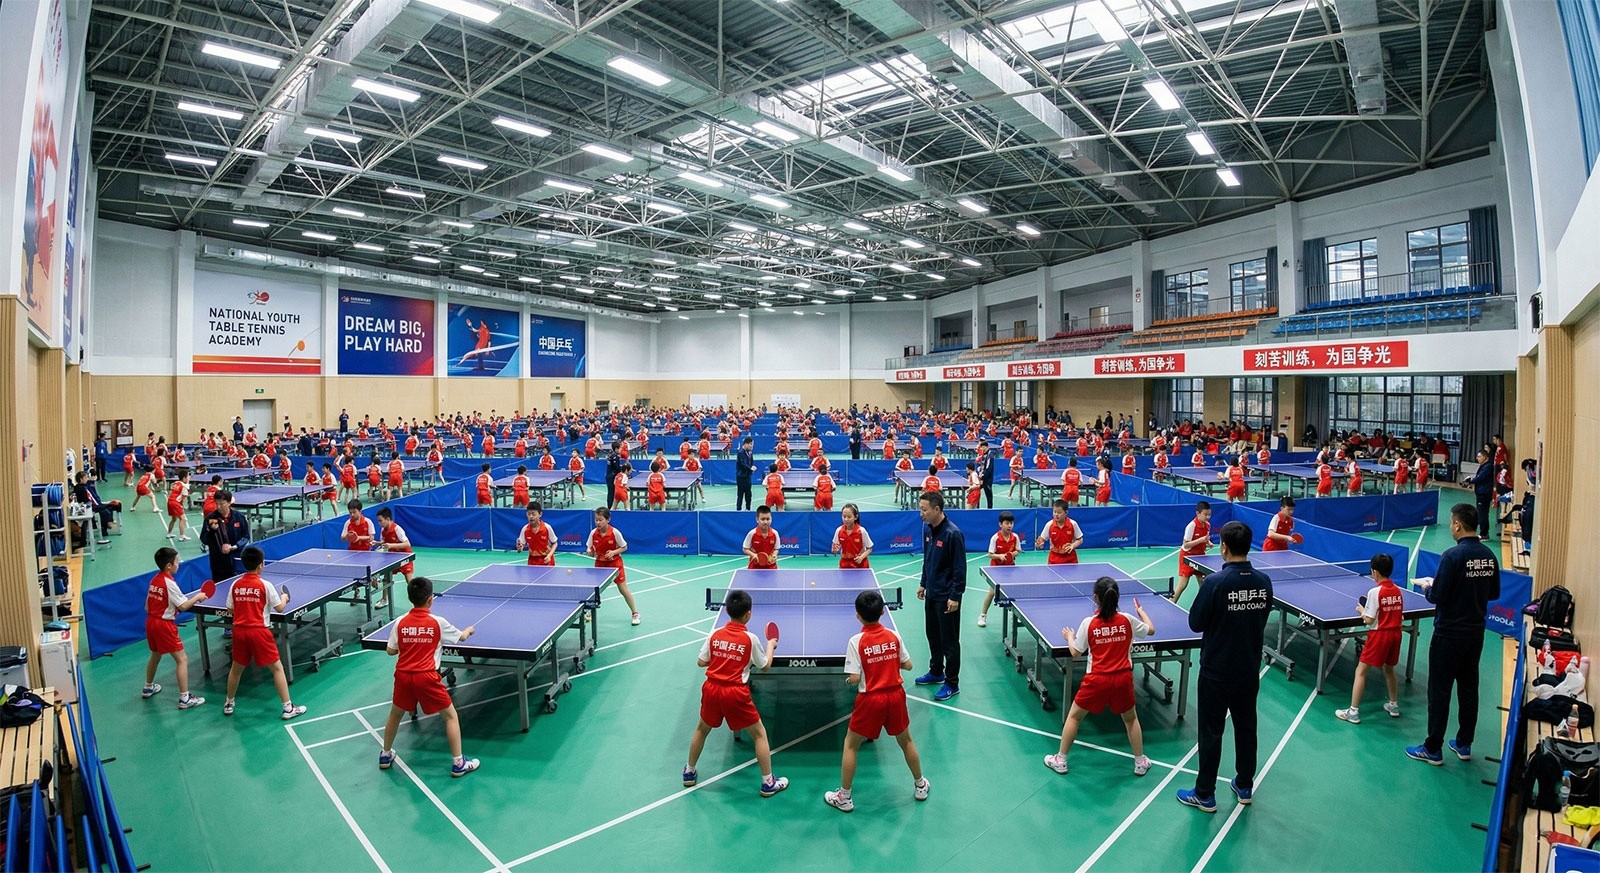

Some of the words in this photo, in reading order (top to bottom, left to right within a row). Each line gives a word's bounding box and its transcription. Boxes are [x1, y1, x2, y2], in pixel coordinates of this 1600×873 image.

[209, 307, 264, 321] NATIONAL
[267, 312, 300, 324] YOUTH
[209, 321, 244, 333] TABLE
[248, 323, 286, 335] TENNIS
[345, 315, 395, 333] DREAM
[399, 320, 425, 338] BIG,
[208, 335, 262, 346] ACADEMY
[345, 335, 382, 351] PLAY
[385, 337, 422, 353] HARD
[539, 336, 574, 352] 中国乒乓
[1228, 588, 1267, 603] 中国乒乓
[1228, 603, 1246, 611] HEAD
[789, 659, 817, 667] JOOLA
